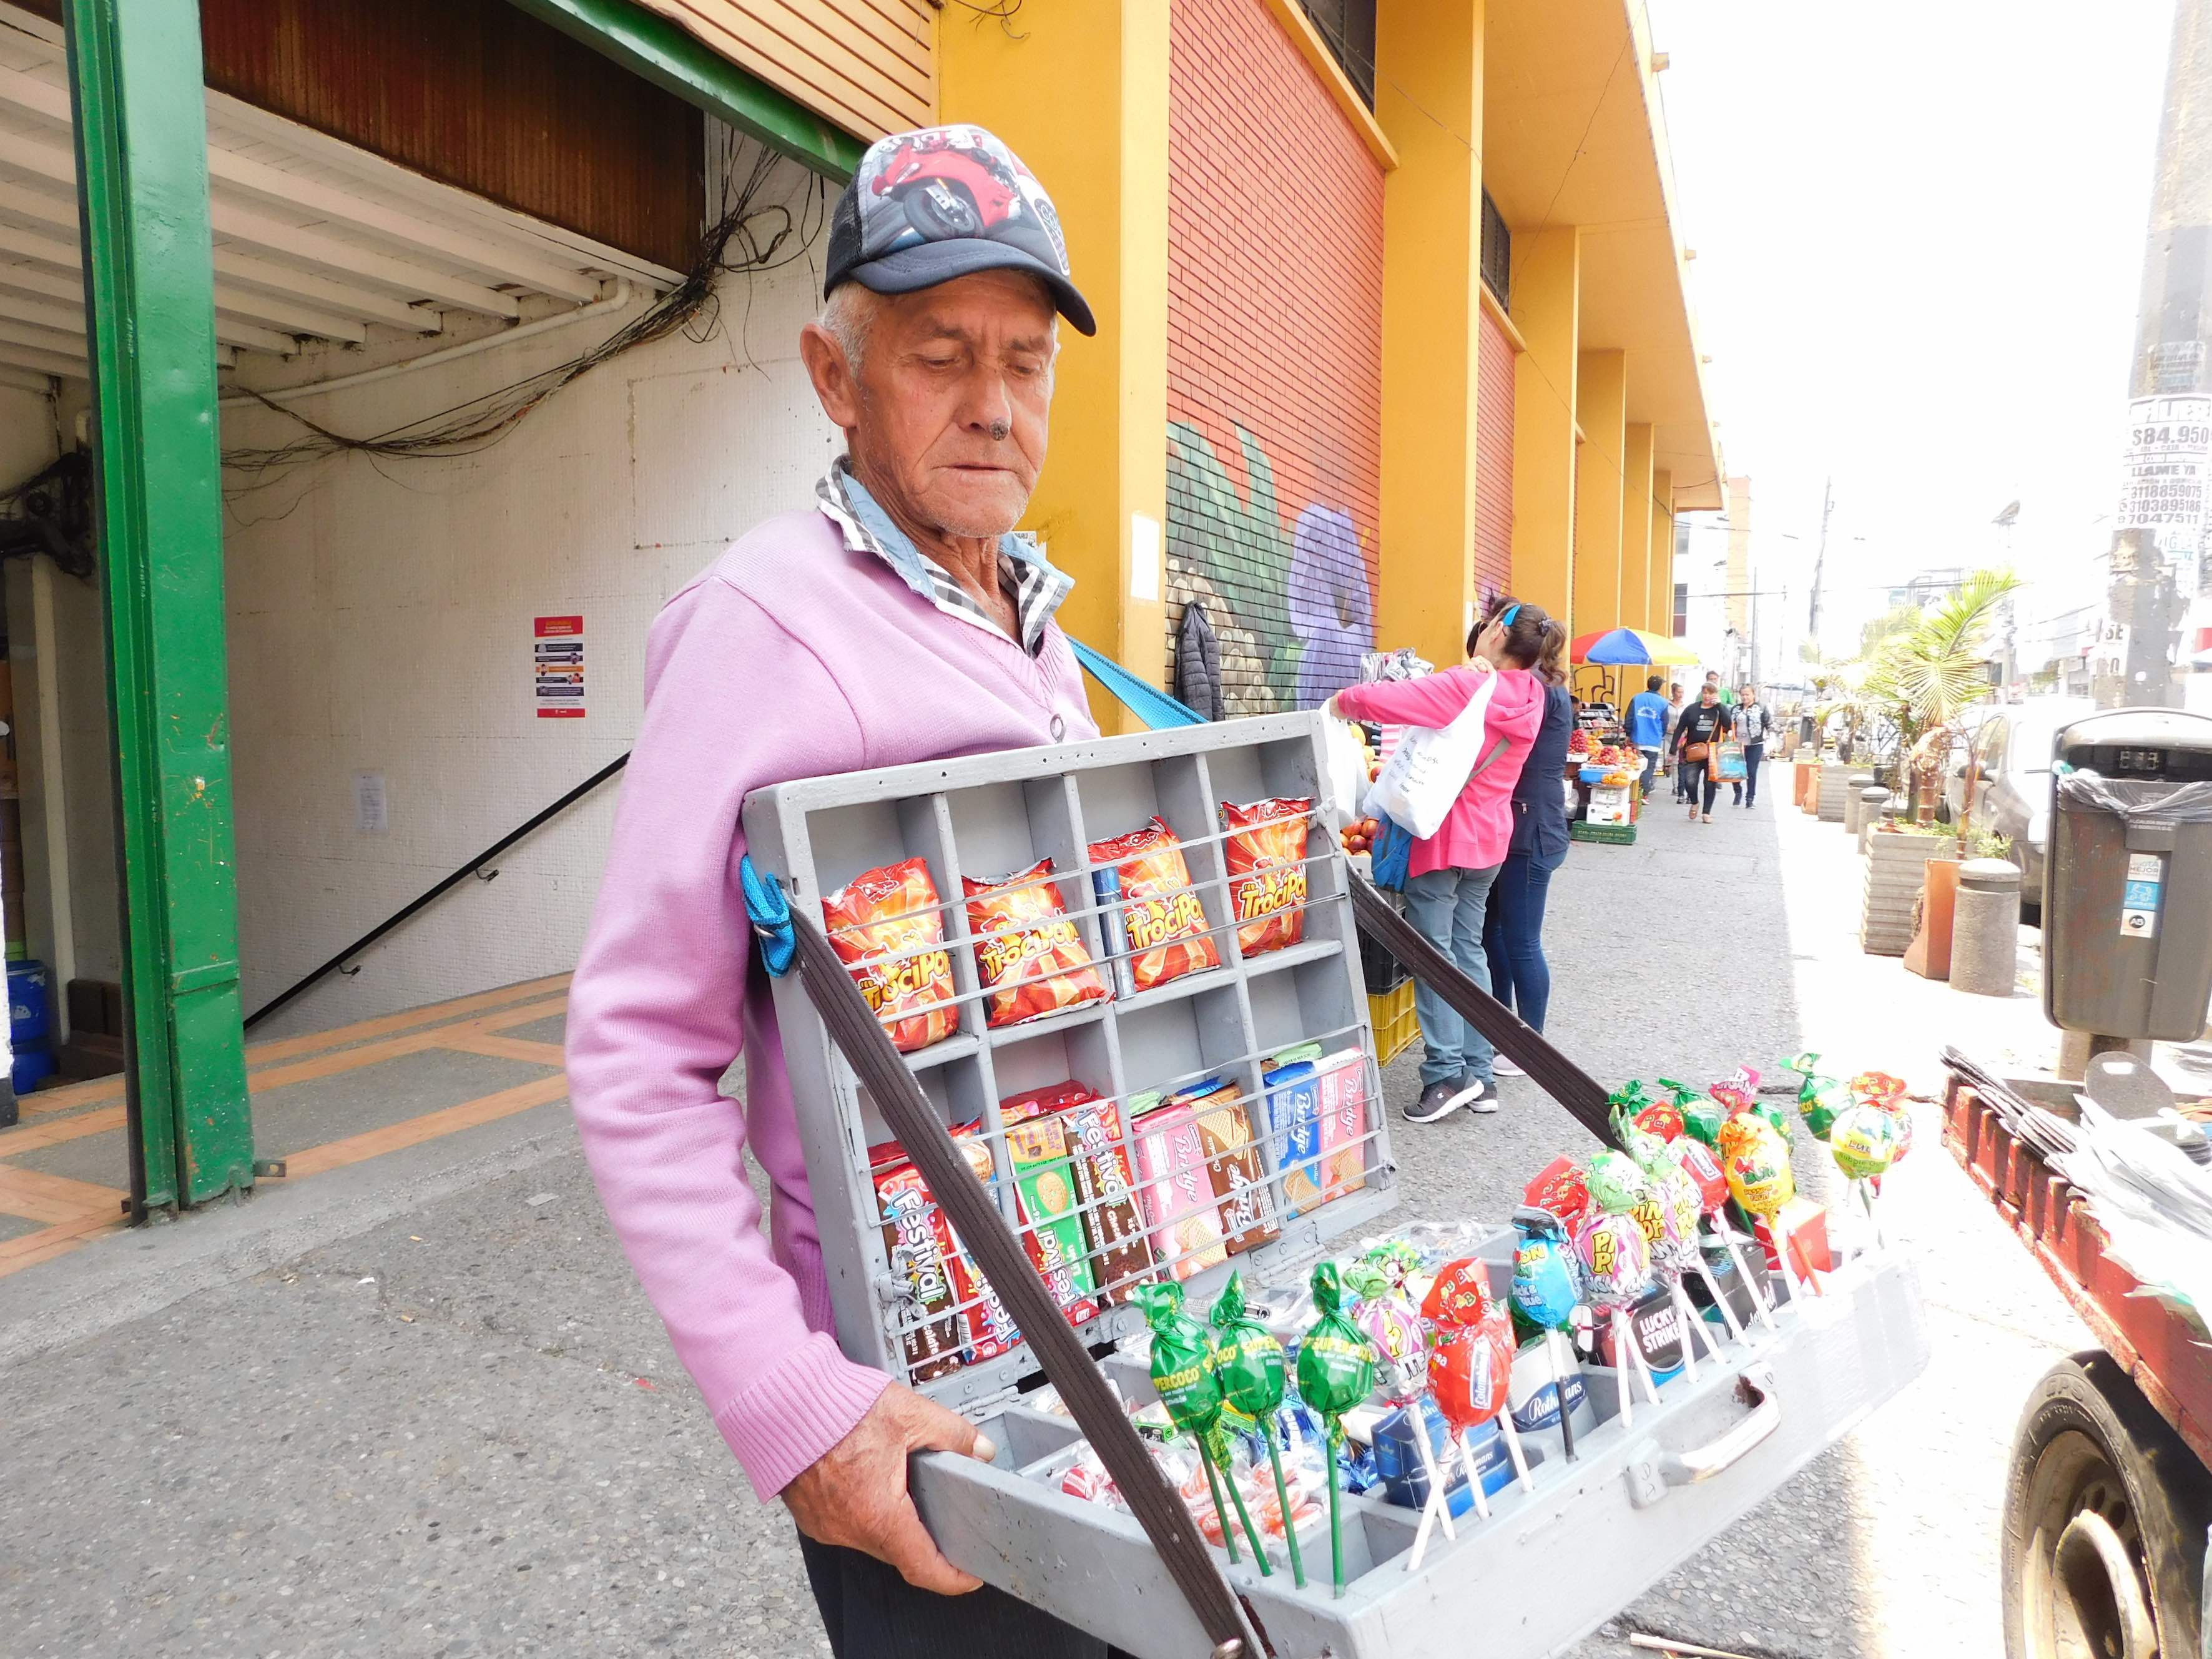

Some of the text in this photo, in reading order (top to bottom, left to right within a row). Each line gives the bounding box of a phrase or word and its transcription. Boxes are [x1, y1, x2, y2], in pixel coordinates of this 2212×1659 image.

[2132, 425, 2209, 446] $84.950
[2131, 465, 2196, 476] LLAME YA
[2129, 513, 2198, 524] 7047511
[1240, 874, 1307, 920] TrociPo
[1127, 893, 1204, 949] TrociPo
[1290, 1091, 1311, 1154] Bridge
[1340, 1077, 1357, 1136] Bridge
[1077, 1110, 1128, 1206] Festival
[1174, 1136, 1198, 1203] Bridge
[1207, 1135, 1222, 1173] Chcolate
[891, 1187, 947, 1299] Festival
[1107, 1210, 1128, 1256] Chocolte
[1593, 1231, 1616, 1253] PI
[1643, 1218, 1664, 1241] OP
[1038, 1228, 1079, 1305] Festival
[973, 1268, 1020, 1343] Festi
[1639, 1305, 1675, 1336] LUCKY
[1643, 1321, 1681, 1353] STRIKE
[1154, 1367, 1199, 1391] PERCOCO
[1529, 1381, 1582, 1421] Rothans
[1456, 1451, 1493, 1478] Romans
